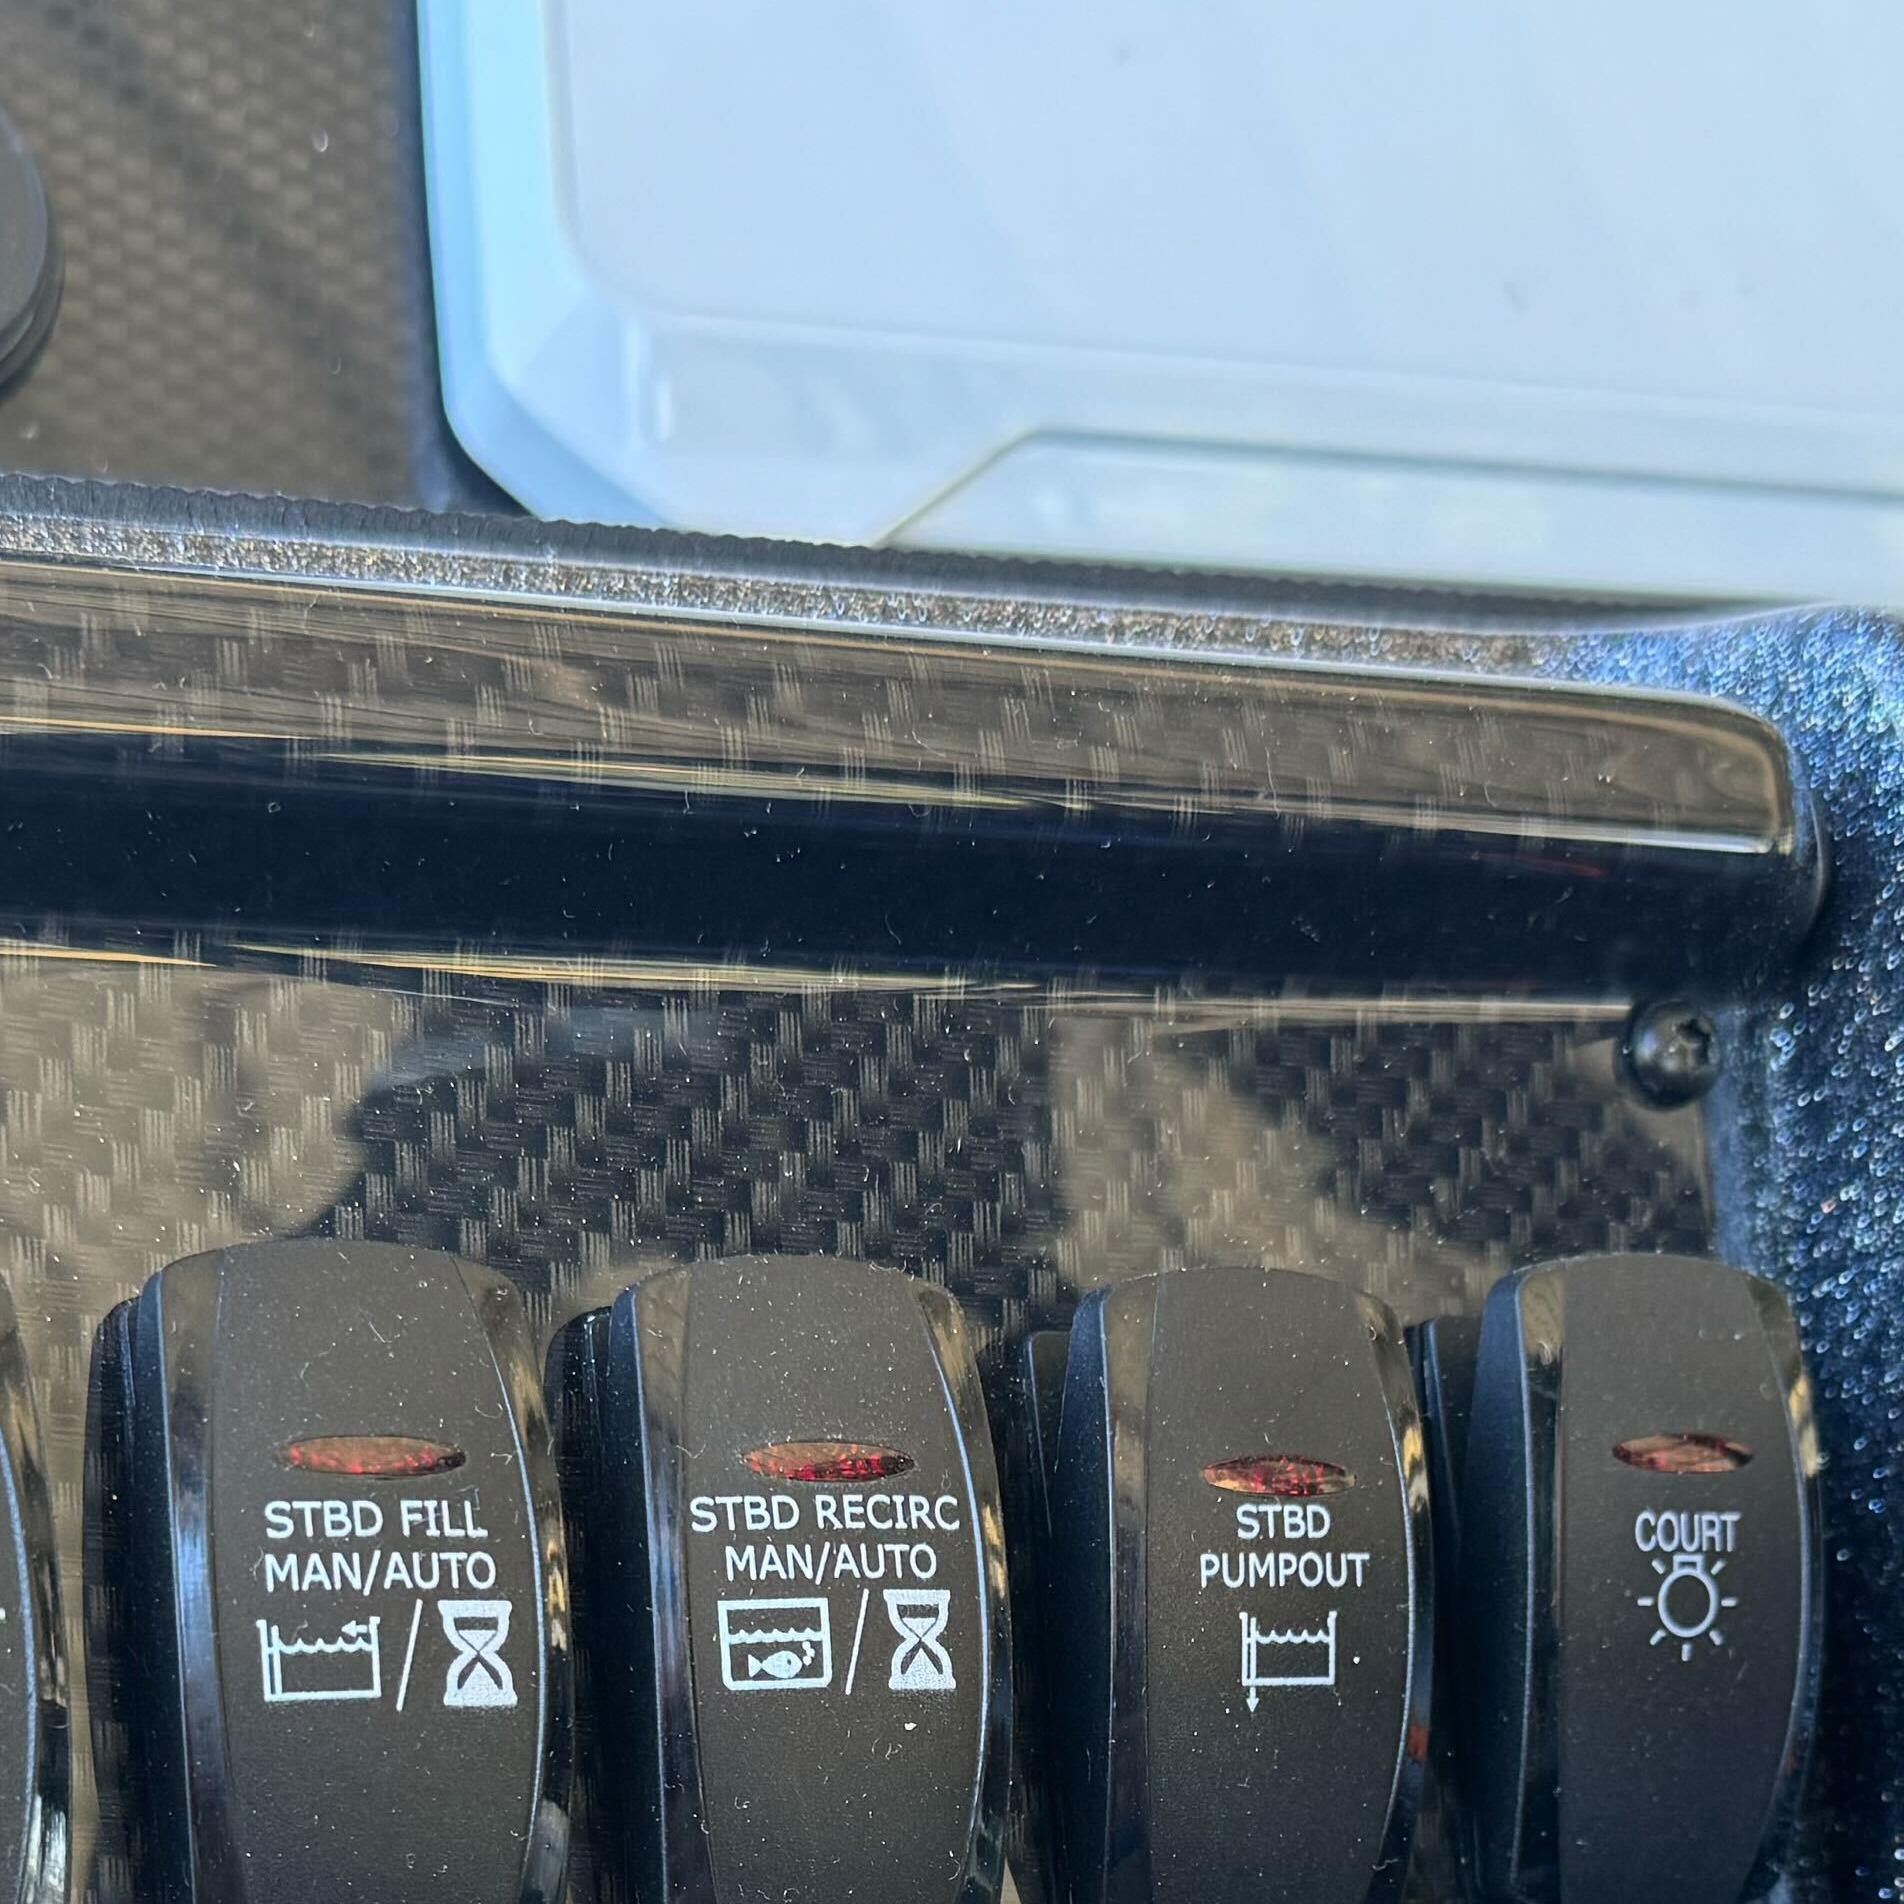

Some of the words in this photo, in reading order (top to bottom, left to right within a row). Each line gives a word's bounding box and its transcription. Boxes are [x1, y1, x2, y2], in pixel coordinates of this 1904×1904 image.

[264, 1500, 384, 1539] STBD
[400, 1500, 489, 1538] FILL
[690, 1495, 800, 1532] STBD
[815, 1494, 960, 1531] RECIRC
[1236, 1504, 1331, 1540] STBD
[1635, 1510, 1741, 1552] COURT
[264, 1550, 496, 1596] MAN/AUTO
[725, 1541, 937, 1585] MAN/AUTO
[1200, 1551, 1370, 1588] PUMPOUT
